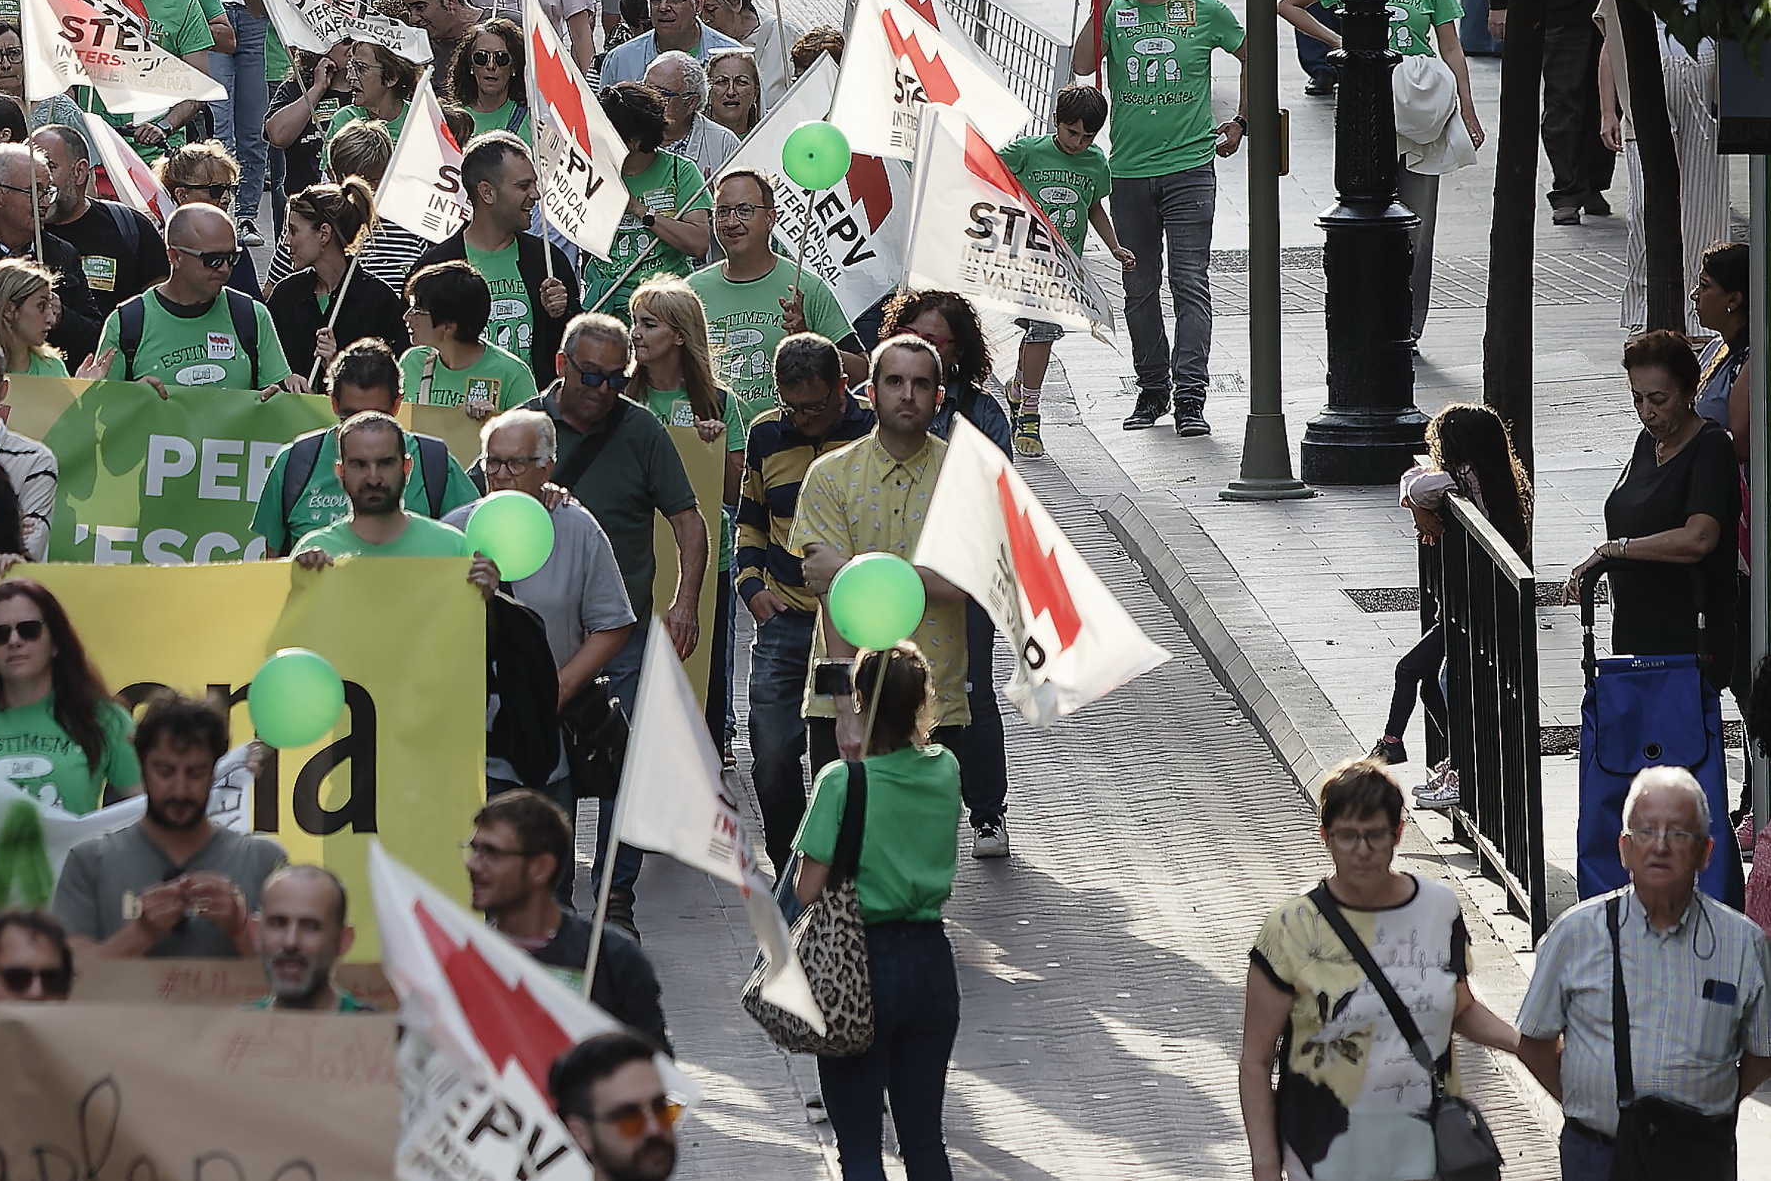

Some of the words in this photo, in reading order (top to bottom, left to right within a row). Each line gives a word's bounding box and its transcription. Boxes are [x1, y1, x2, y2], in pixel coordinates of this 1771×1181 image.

[58, 14, 153, 52] STE
[1124, 21, 1189, 39] ESTIMEM
[566, 147, 605, 200] PV
[428, 193, 471, 221] INTE
[544, 186, 578, 239] CIANA
[553, 170, 588, 225] NDICAL
[804, 185, 877, 268] EPV
[489, 278, 527, 296] TIME
[726, 311, 781, 328] TIMEM
[211, 343, 235, 355] STEPV
[740, 384, 781, 402] PÚBLIC
[466, 1097, 569, 1181] PV
